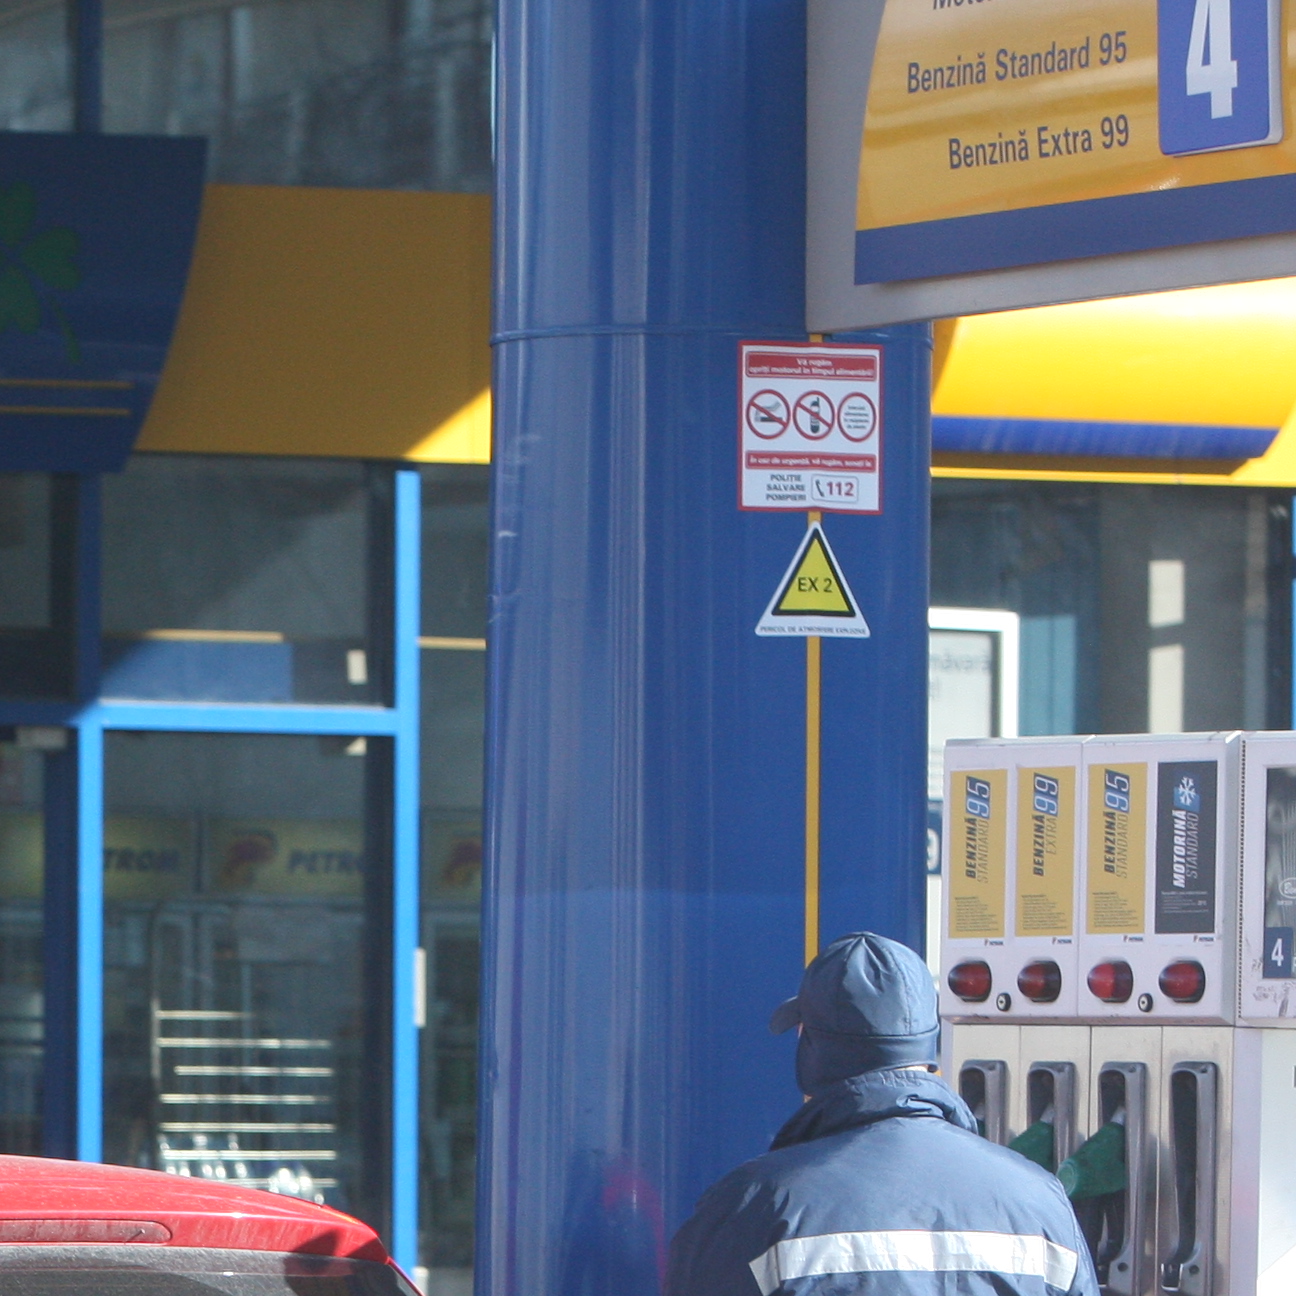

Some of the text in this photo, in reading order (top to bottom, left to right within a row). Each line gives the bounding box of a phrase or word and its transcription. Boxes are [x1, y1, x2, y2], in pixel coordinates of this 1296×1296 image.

[907, 30, 1127, 94] Benzină Standard 95
[1185, 0, 1238, 120] 4
[948, 114, 1130, 169] Benzină Extra 99
[766, 493, 806, 501] POMPIERI
[767, 483, 805, 492] SALVARE
[826, 481, 855, 497] 112
[797, 577, 833, 592] EX 2
[966, 780, 991, 818] 95
[1034, 775, 1058, 815] 99
[1105, 773, 1130, 812] 95
[964, 817, 978, 879] BENZINĂ
[977, 820, 990, 884] STANDARD
[1032, 815, 1045, 877] BENZINĂ
[1046, 817, 1057, 855] EXTRA
[1103, 811, 1116, 874] BENZINĂ
[1116, 814, 1129, 879] STANDARD
[1172, 809, 1187, 888] MOTORINĂ
[1186, 811, 1200, 879] STANDARD
[1271, 937, 1284, 967] 4
